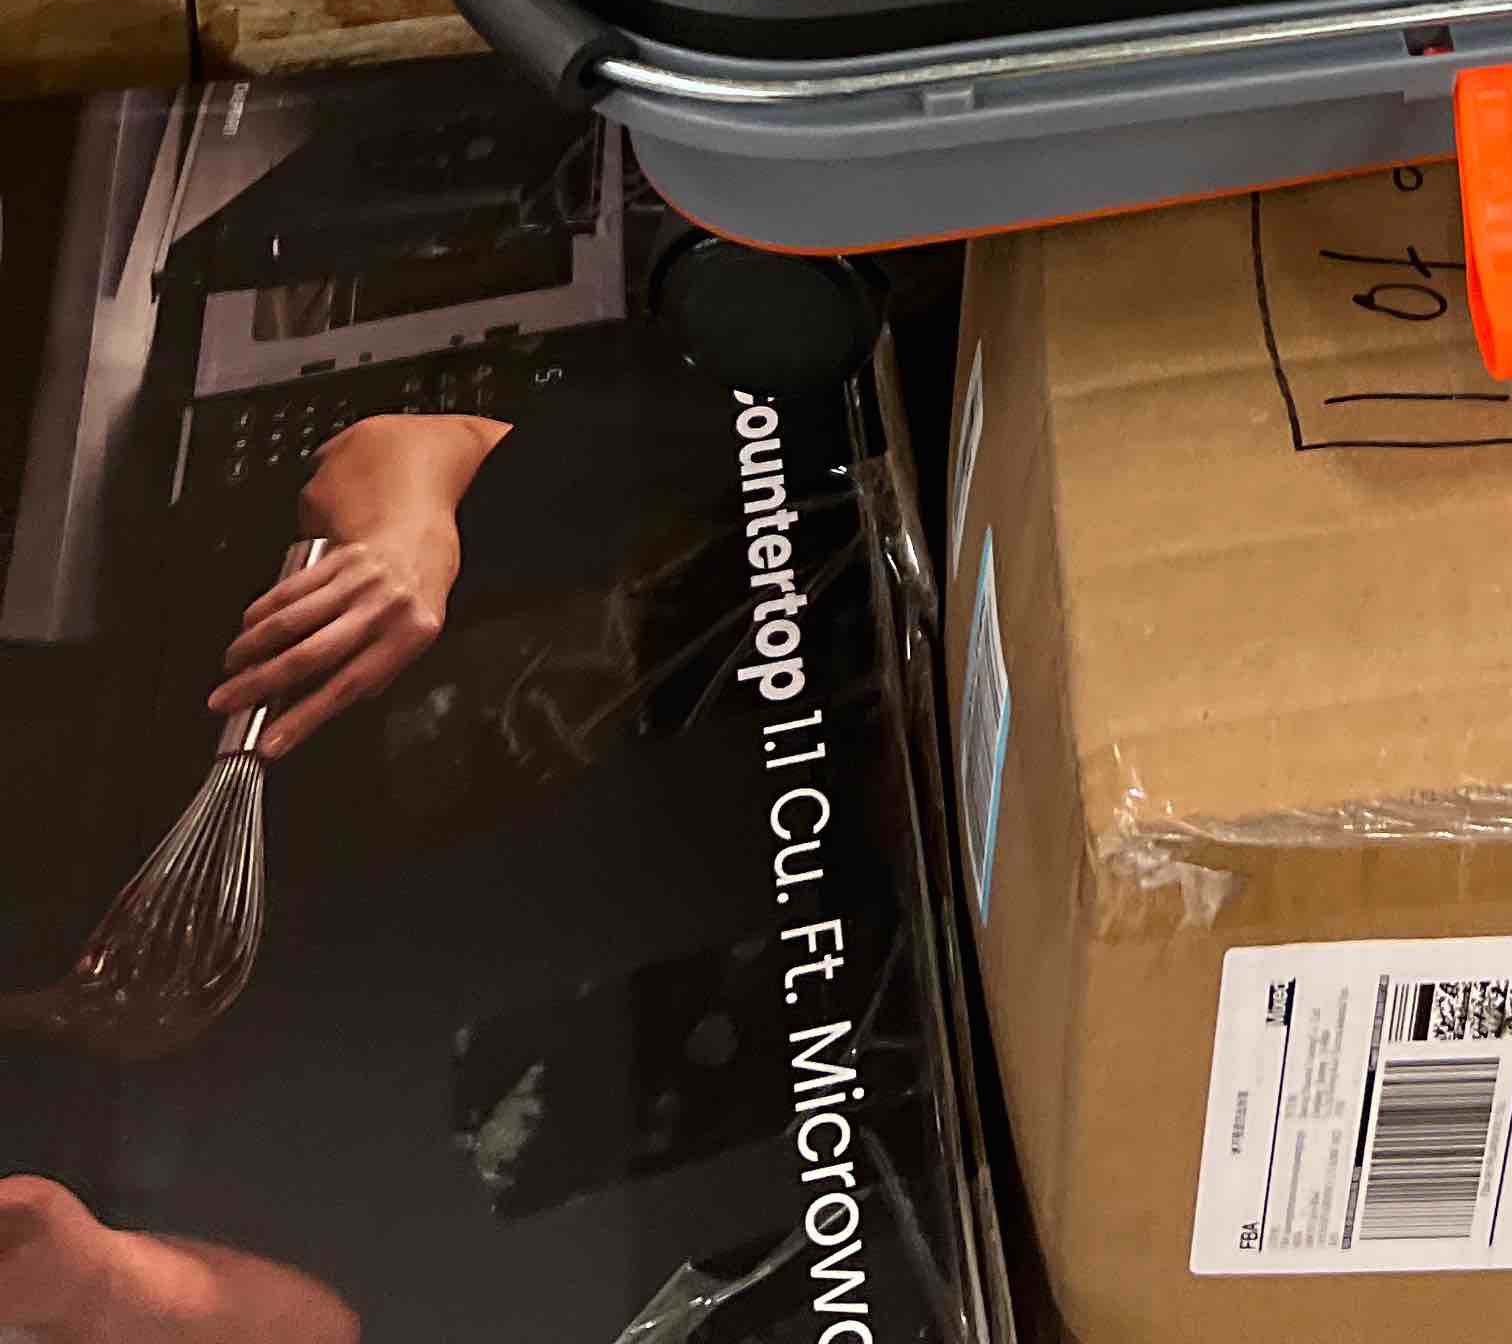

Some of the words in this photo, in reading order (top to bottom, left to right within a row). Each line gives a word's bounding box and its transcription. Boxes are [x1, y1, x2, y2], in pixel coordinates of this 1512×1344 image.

[733, 389, 808, 702] ountertop
[762, 709, 827, 772] 1.1
[769, 787, 832, 905] Cu.
[779, 919, 846, 1005] Ft.
[1238, 1220, 1260, 1252] FBA
